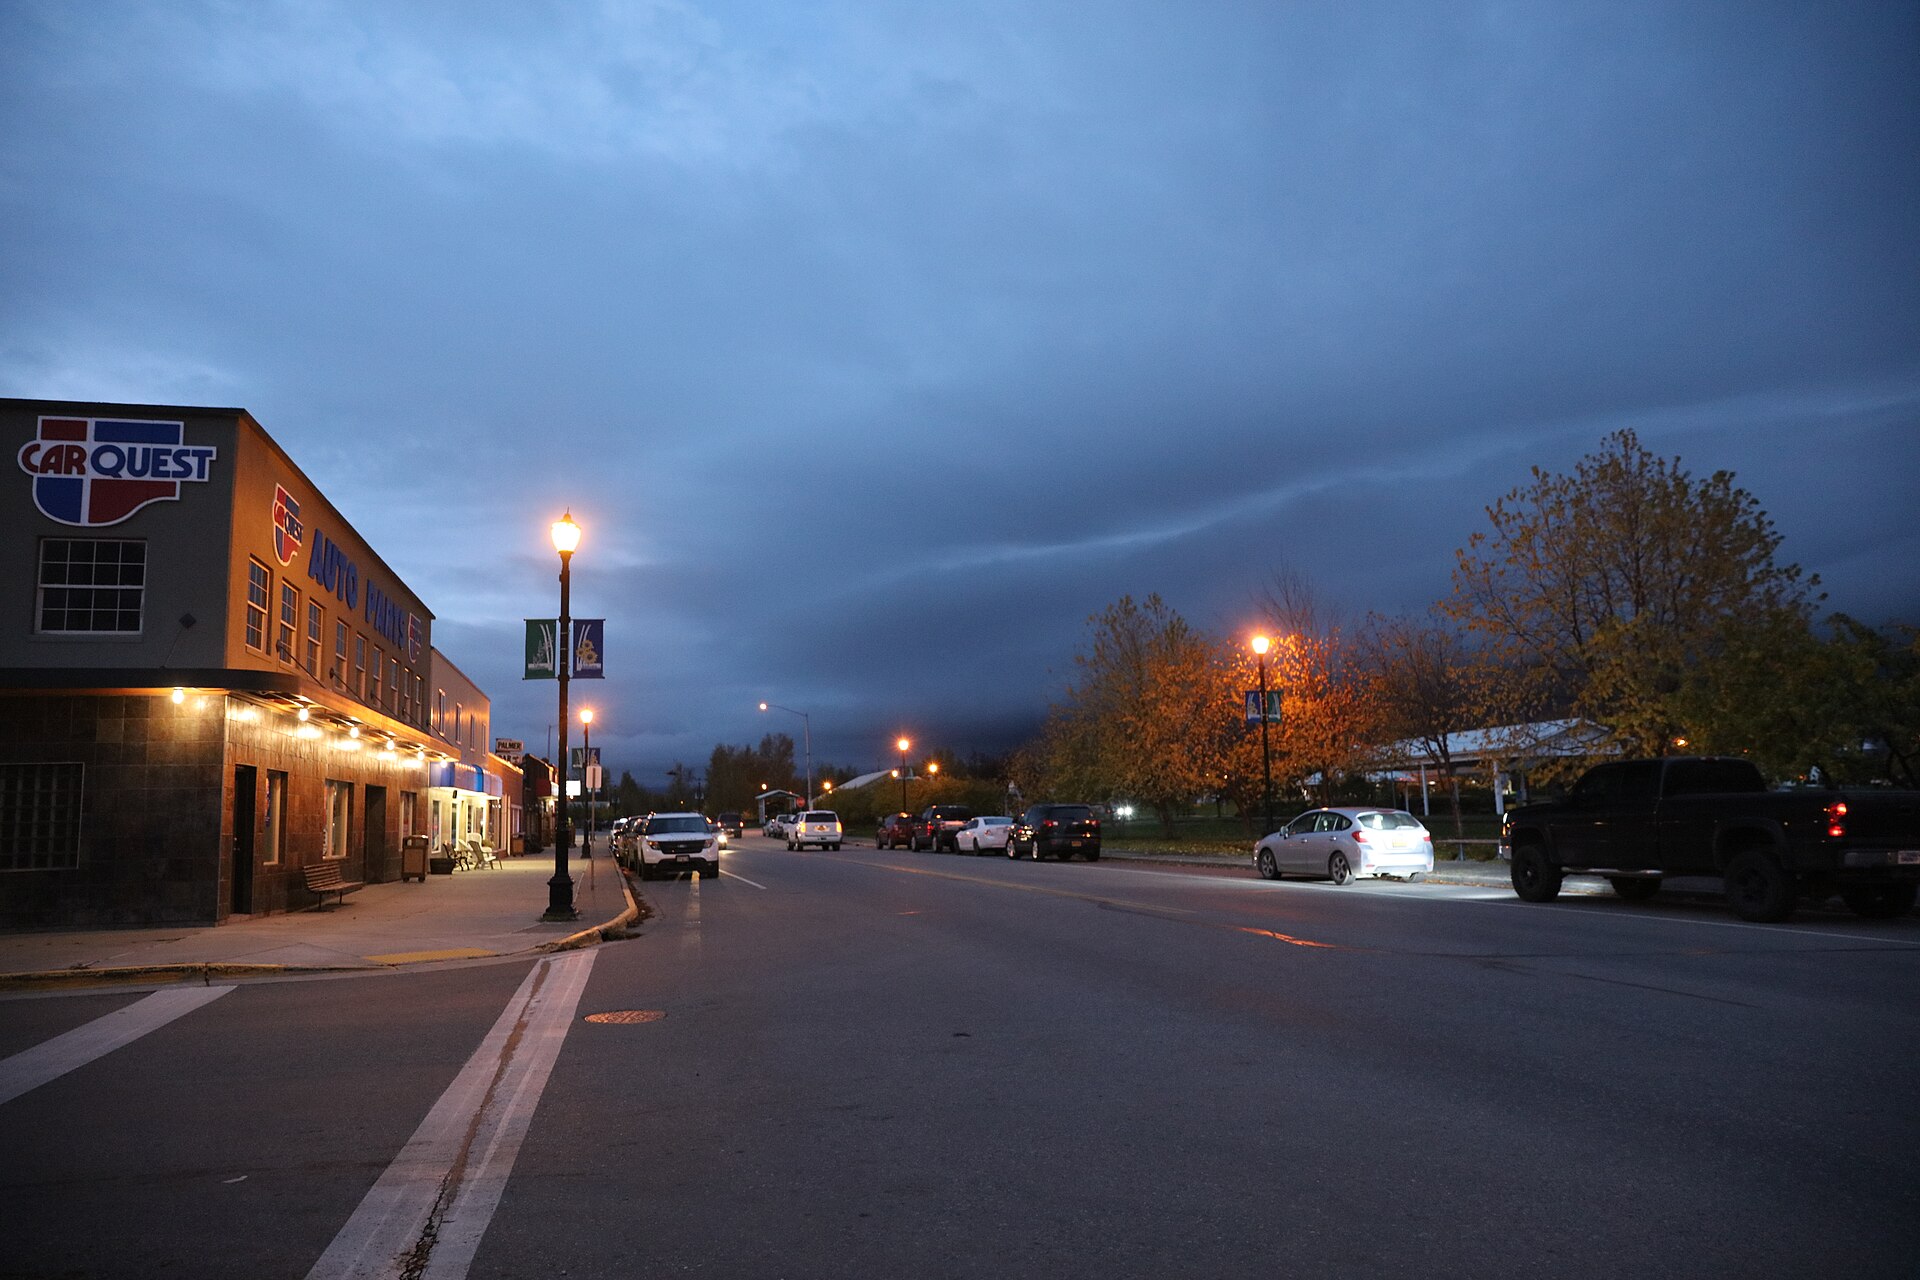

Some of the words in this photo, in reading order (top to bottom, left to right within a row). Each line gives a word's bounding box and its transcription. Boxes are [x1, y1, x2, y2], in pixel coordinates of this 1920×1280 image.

[308, 528, 357, 610] AUTO
[366, 579, 405, 650] PARTS
[497, 741, 520, 750] PALMER
